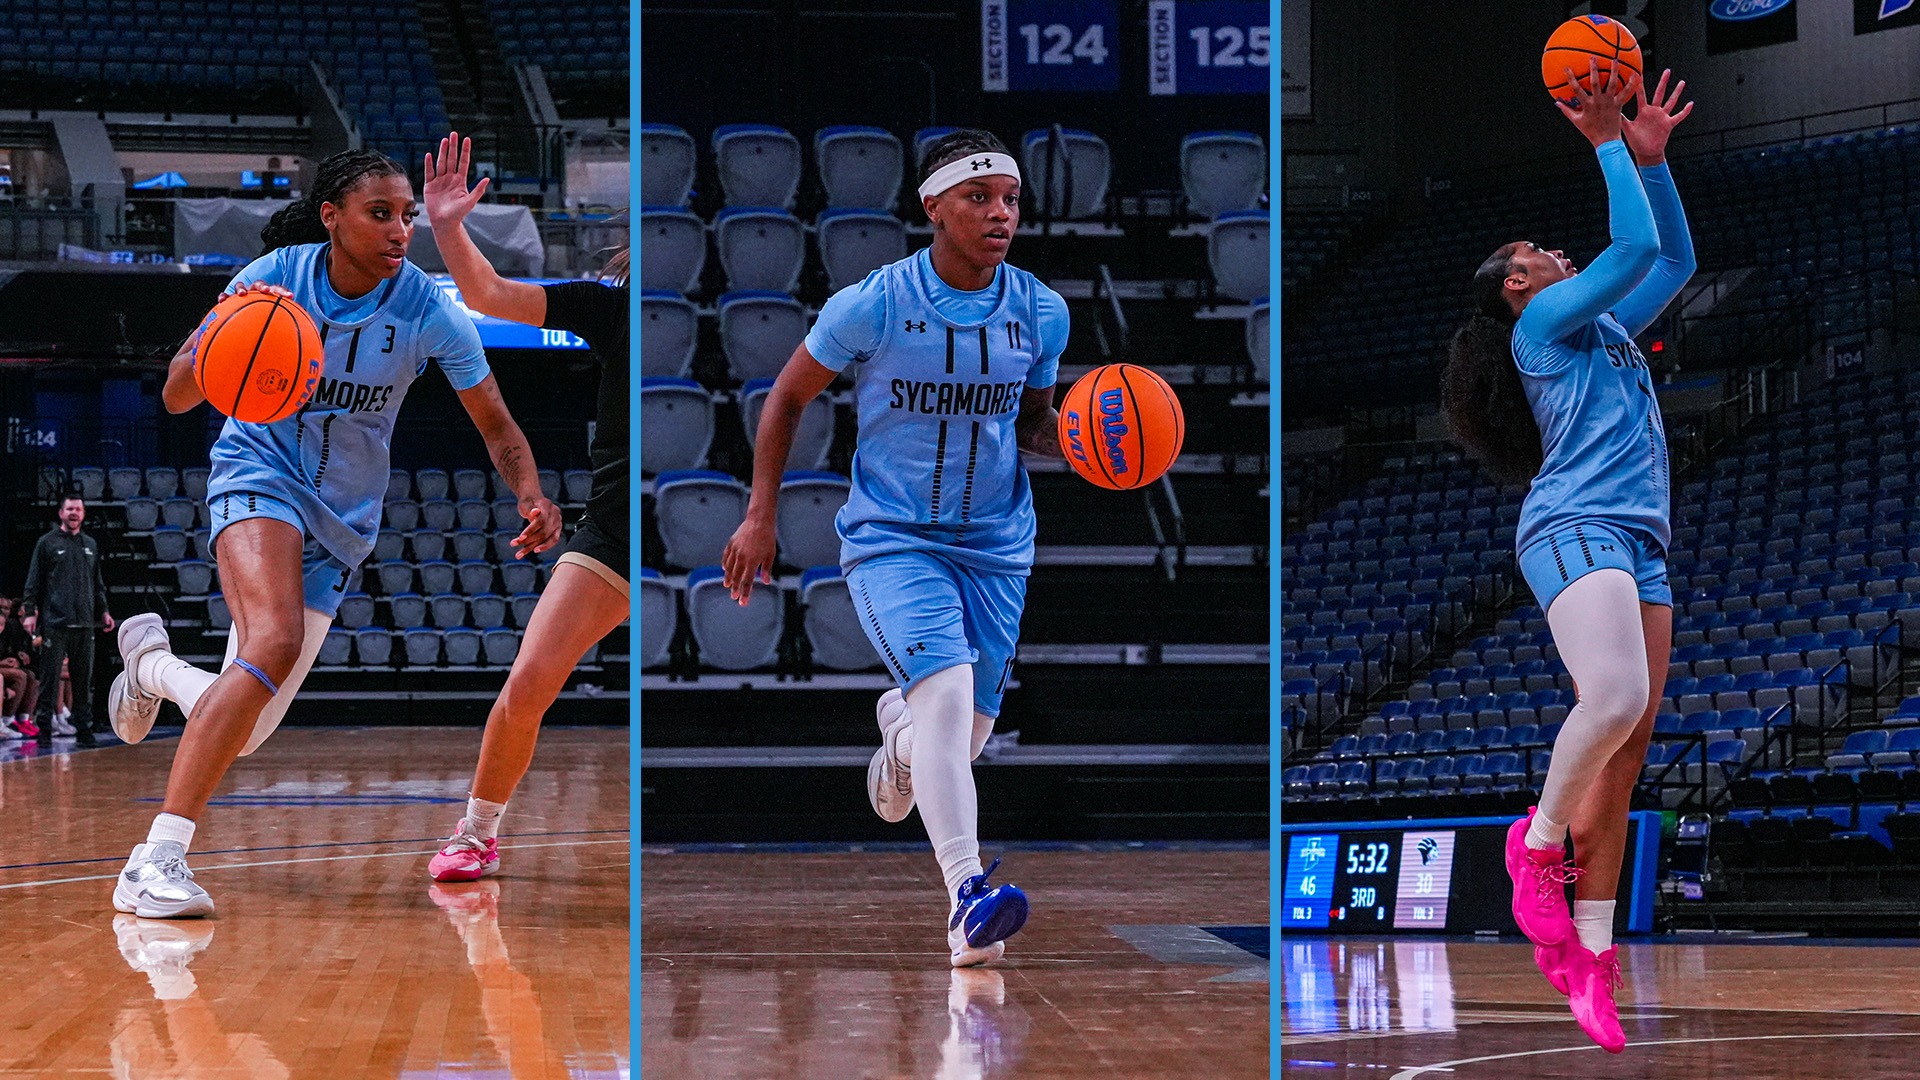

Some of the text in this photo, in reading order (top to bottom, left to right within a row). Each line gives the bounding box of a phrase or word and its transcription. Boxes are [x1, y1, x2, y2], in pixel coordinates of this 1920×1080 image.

[988, 4, 1001, 81] SECTION
[1019, 24, 1109, 64] 124
[1155, 8, 1170, 84] SECTION
[1190, 26, 1270, 67] 125
[381, 325, 396, 353] 3
[540, 328, 571, 346] TOL
[1005, 321, 1021, 349] 11
[1836, 350, 1863, 367] 104
[310, 376, 394, 414] MORES
[890, 378, 1022, 416] SYCAMORES
[1099, 387, 1128, 477] Wilson
[1347, 843, 1389, 874] 5:32
[1300, 875, 1316, 896] 46
[1350, 887, 1376, 908] 3RD
[1415, 873, 1434, 895] 30
[1292, 906, 1312, 920] TOL 3
[1413, 906, 1434, 920] TOL 3
